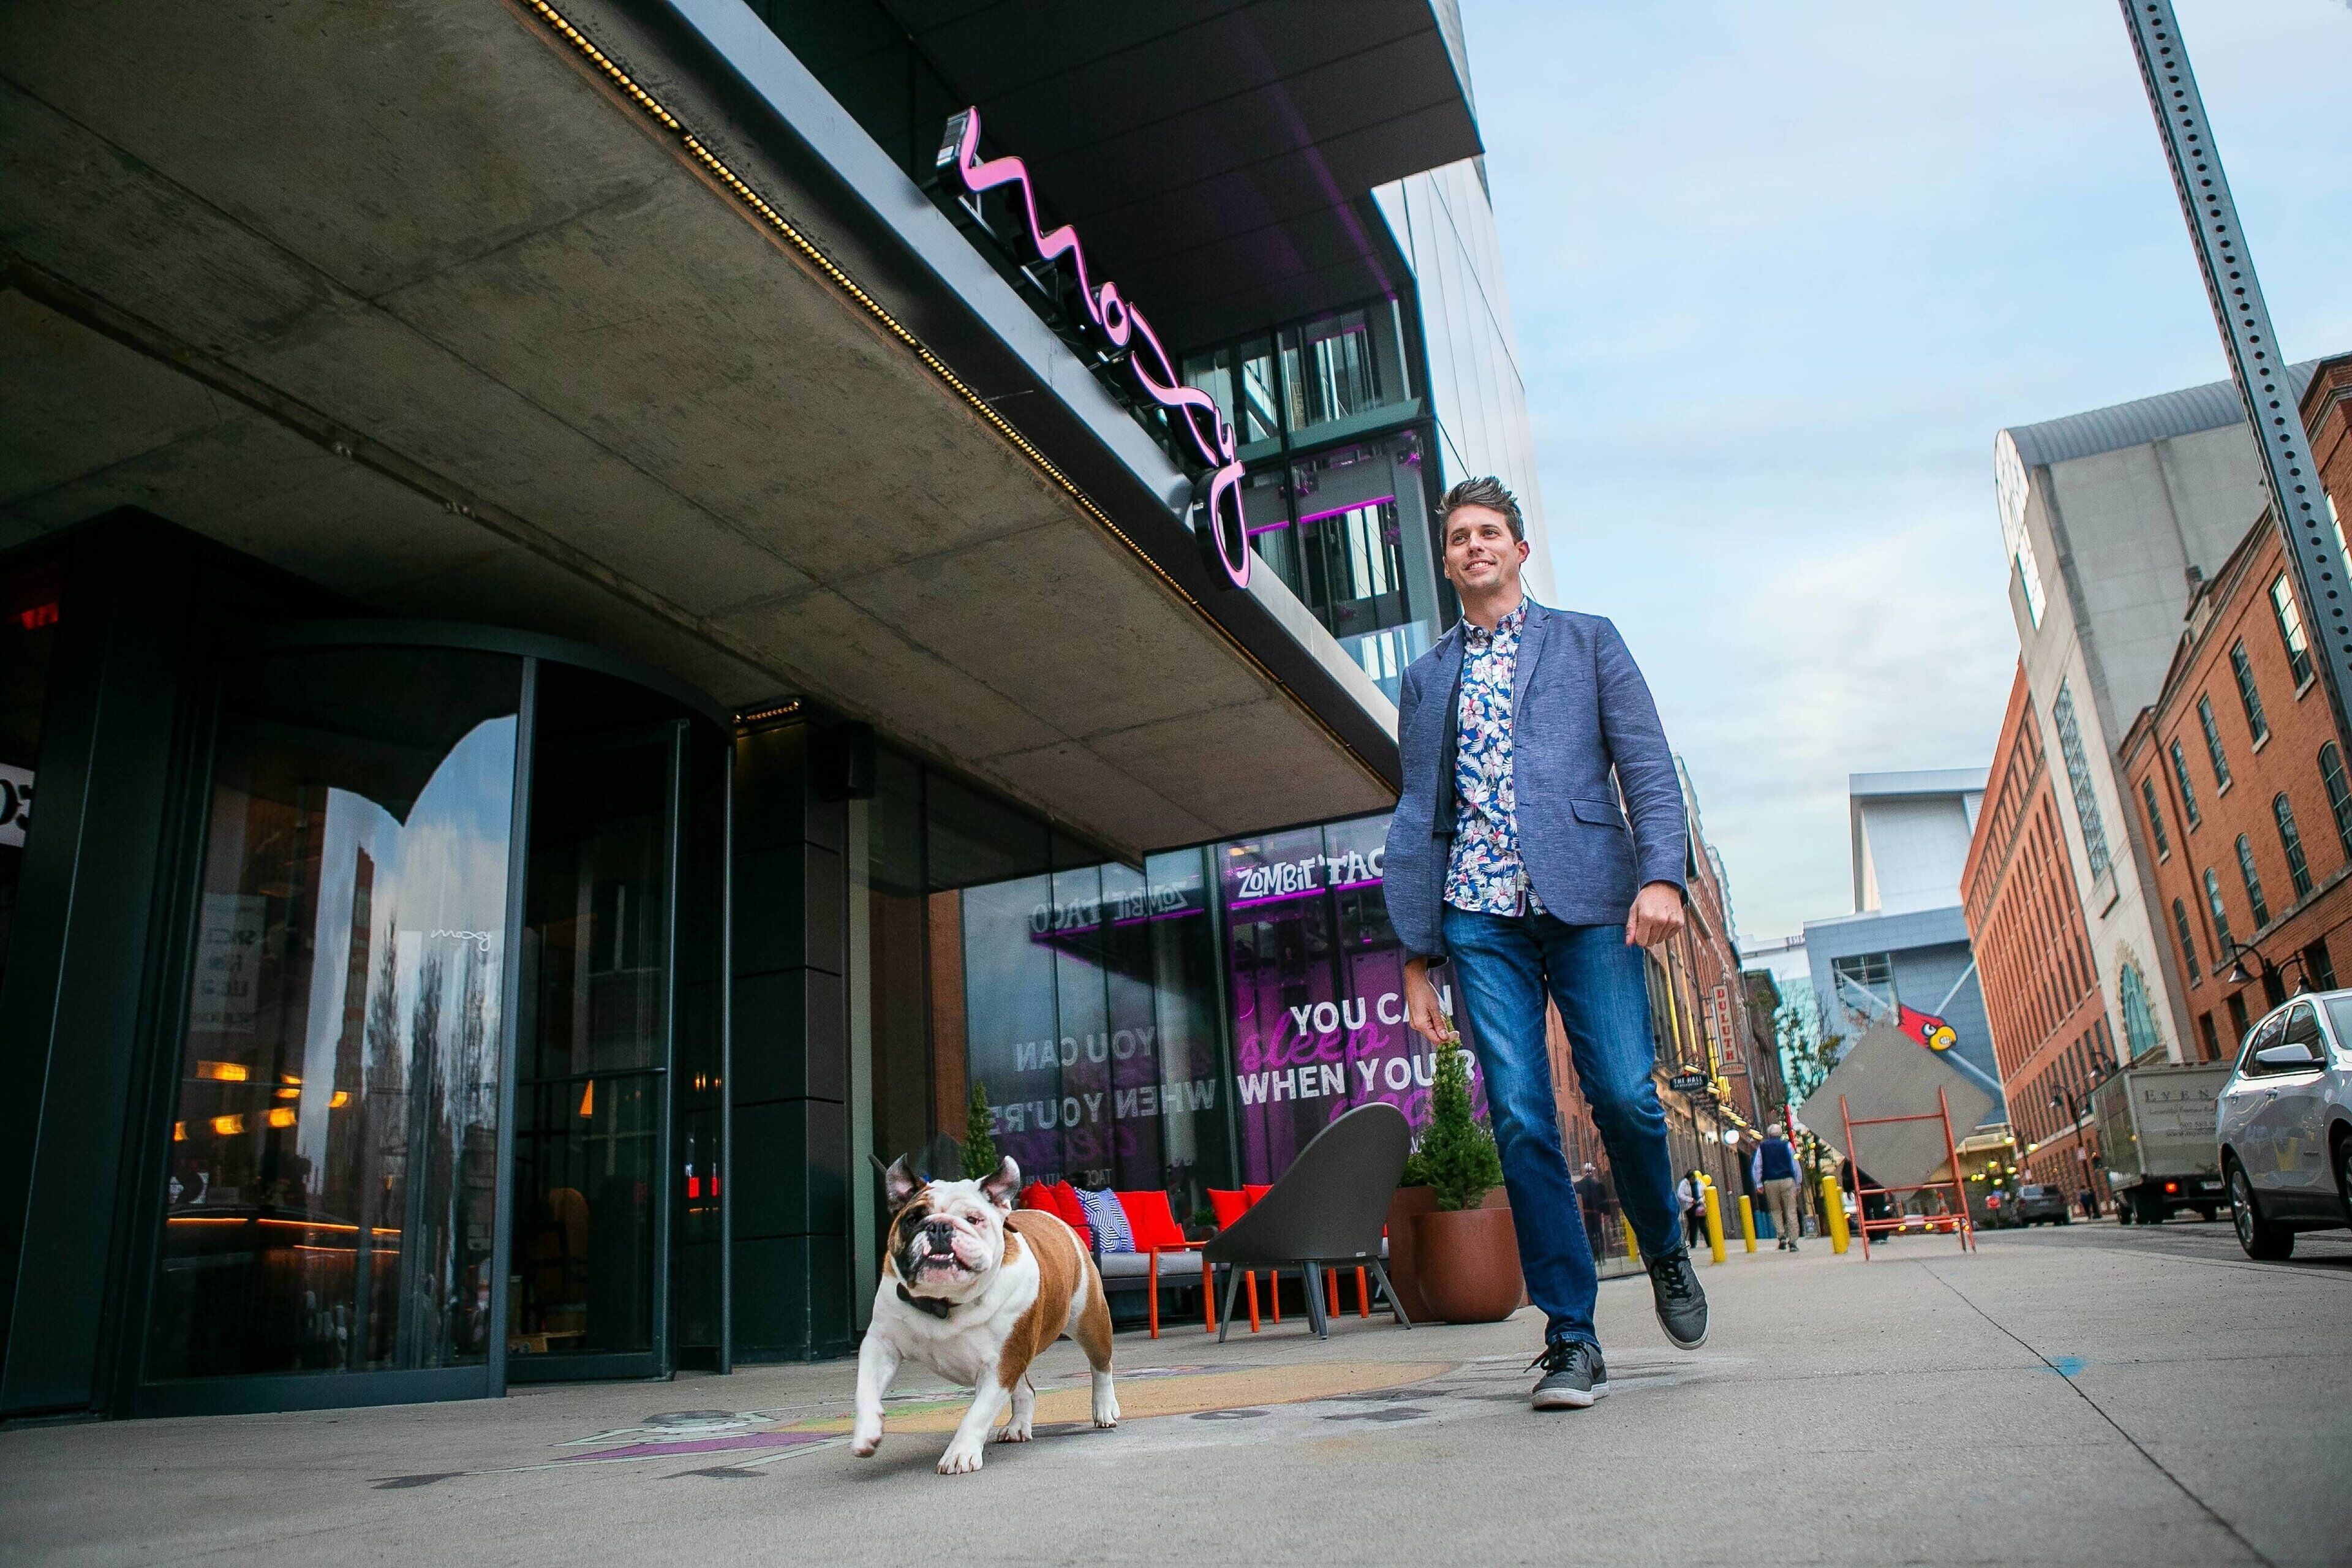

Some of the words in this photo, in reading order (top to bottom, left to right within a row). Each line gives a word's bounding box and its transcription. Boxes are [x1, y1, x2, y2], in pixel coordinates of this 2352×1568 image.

[1318, 845, 1386, 885] TAC
[1290, 997, 1367, 1036] YOU
[1376, 984, 1454, 1025] CN
[1717, 988, 1735, 1061] DULUTH
[1238, 1011, 1390, 1071] sleep
[1237, 1062, 1346, 1106] WHEN
